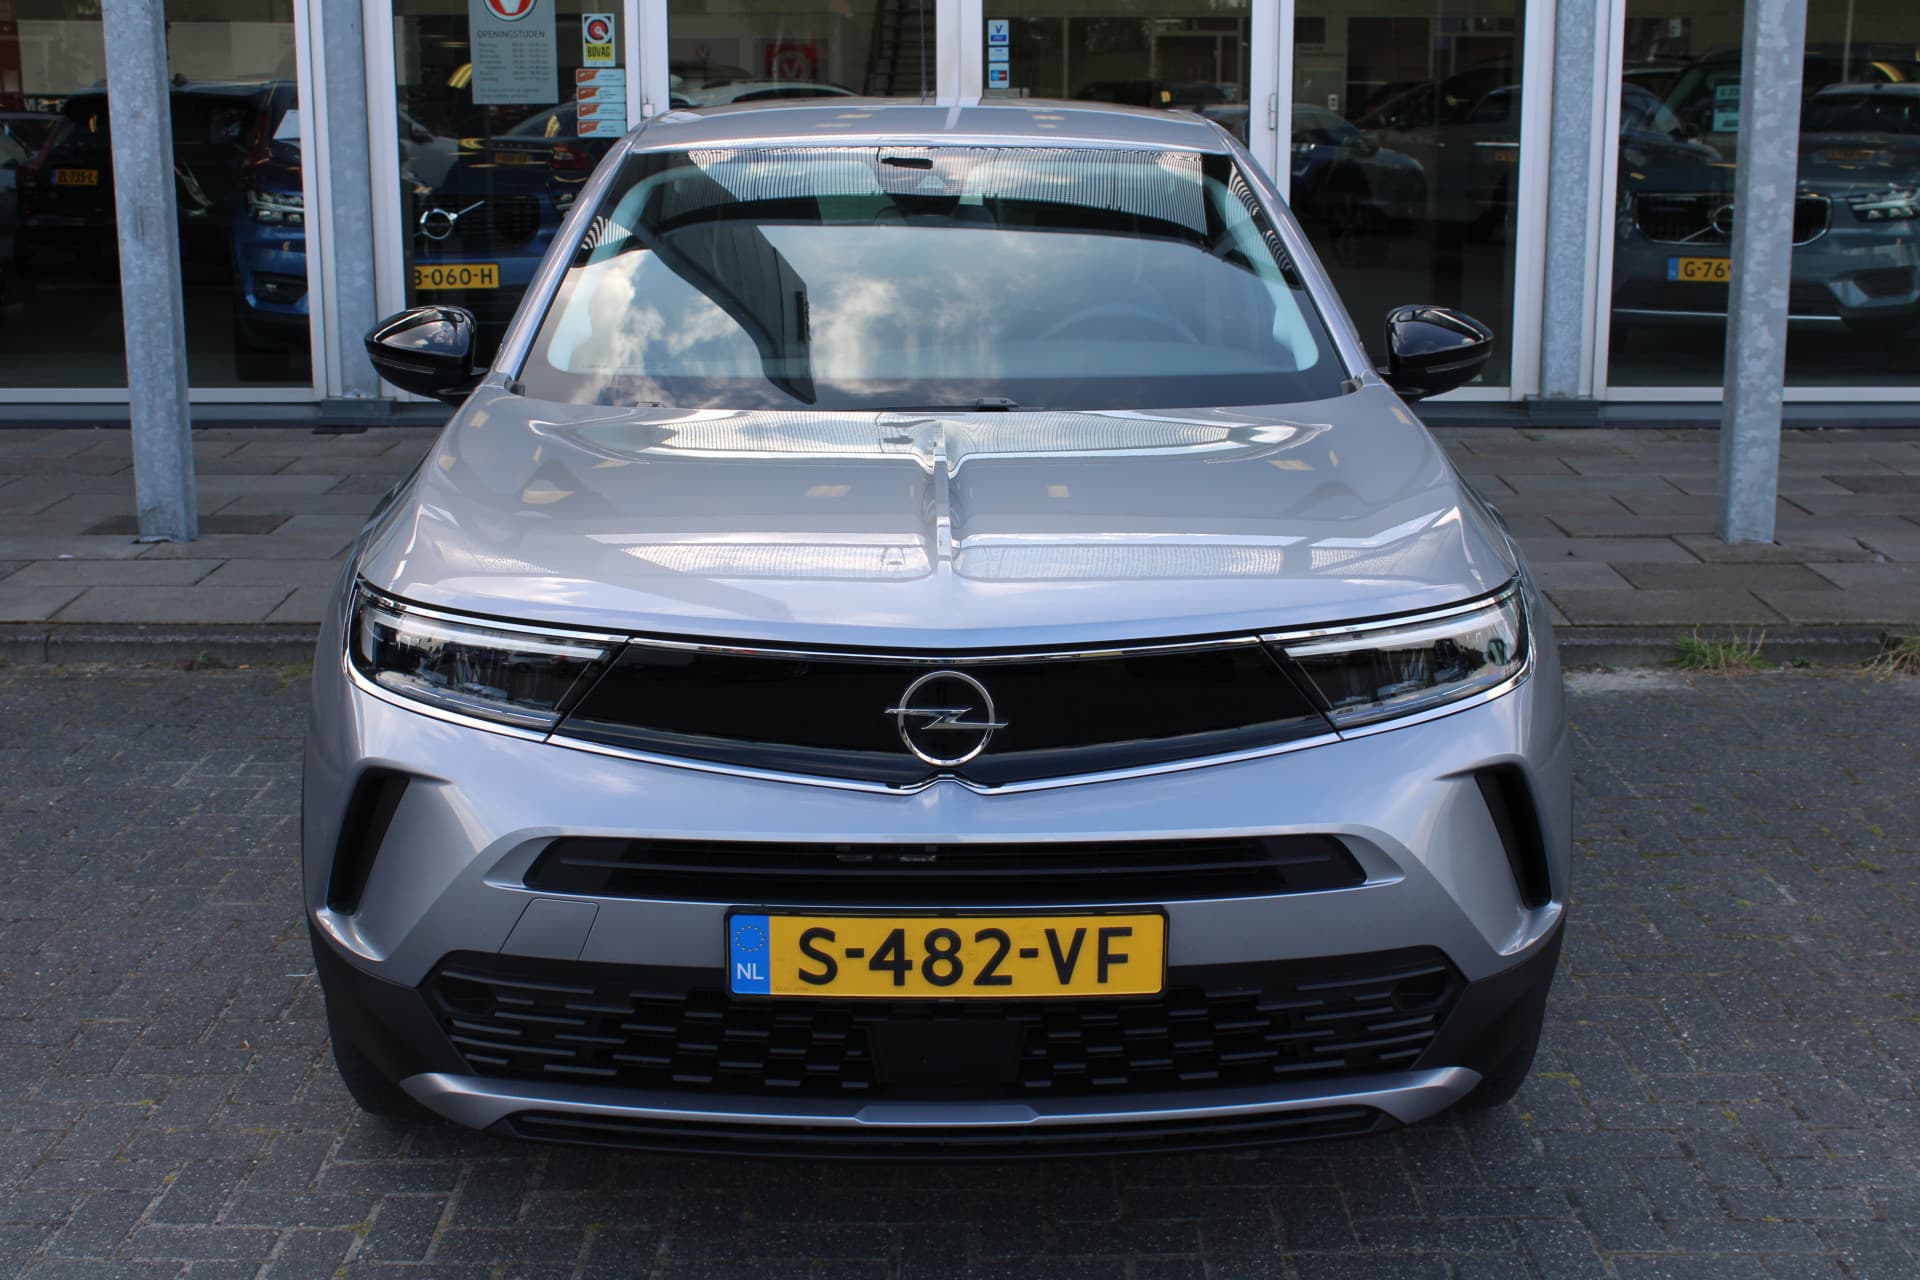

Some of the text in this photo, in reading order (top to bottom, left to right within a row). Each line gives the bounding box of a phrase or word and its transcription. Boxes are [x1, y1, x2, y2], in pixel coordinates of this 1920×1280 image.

[477, 30, 545, 39] OPENINGSTIJDEN
[587, 45, 611, 57] BOVAG
[1684, 261, 1731, 278] G-76
[797, 926, 1134, 986] S-482-VF
[736, 962, 764, 981] NL
